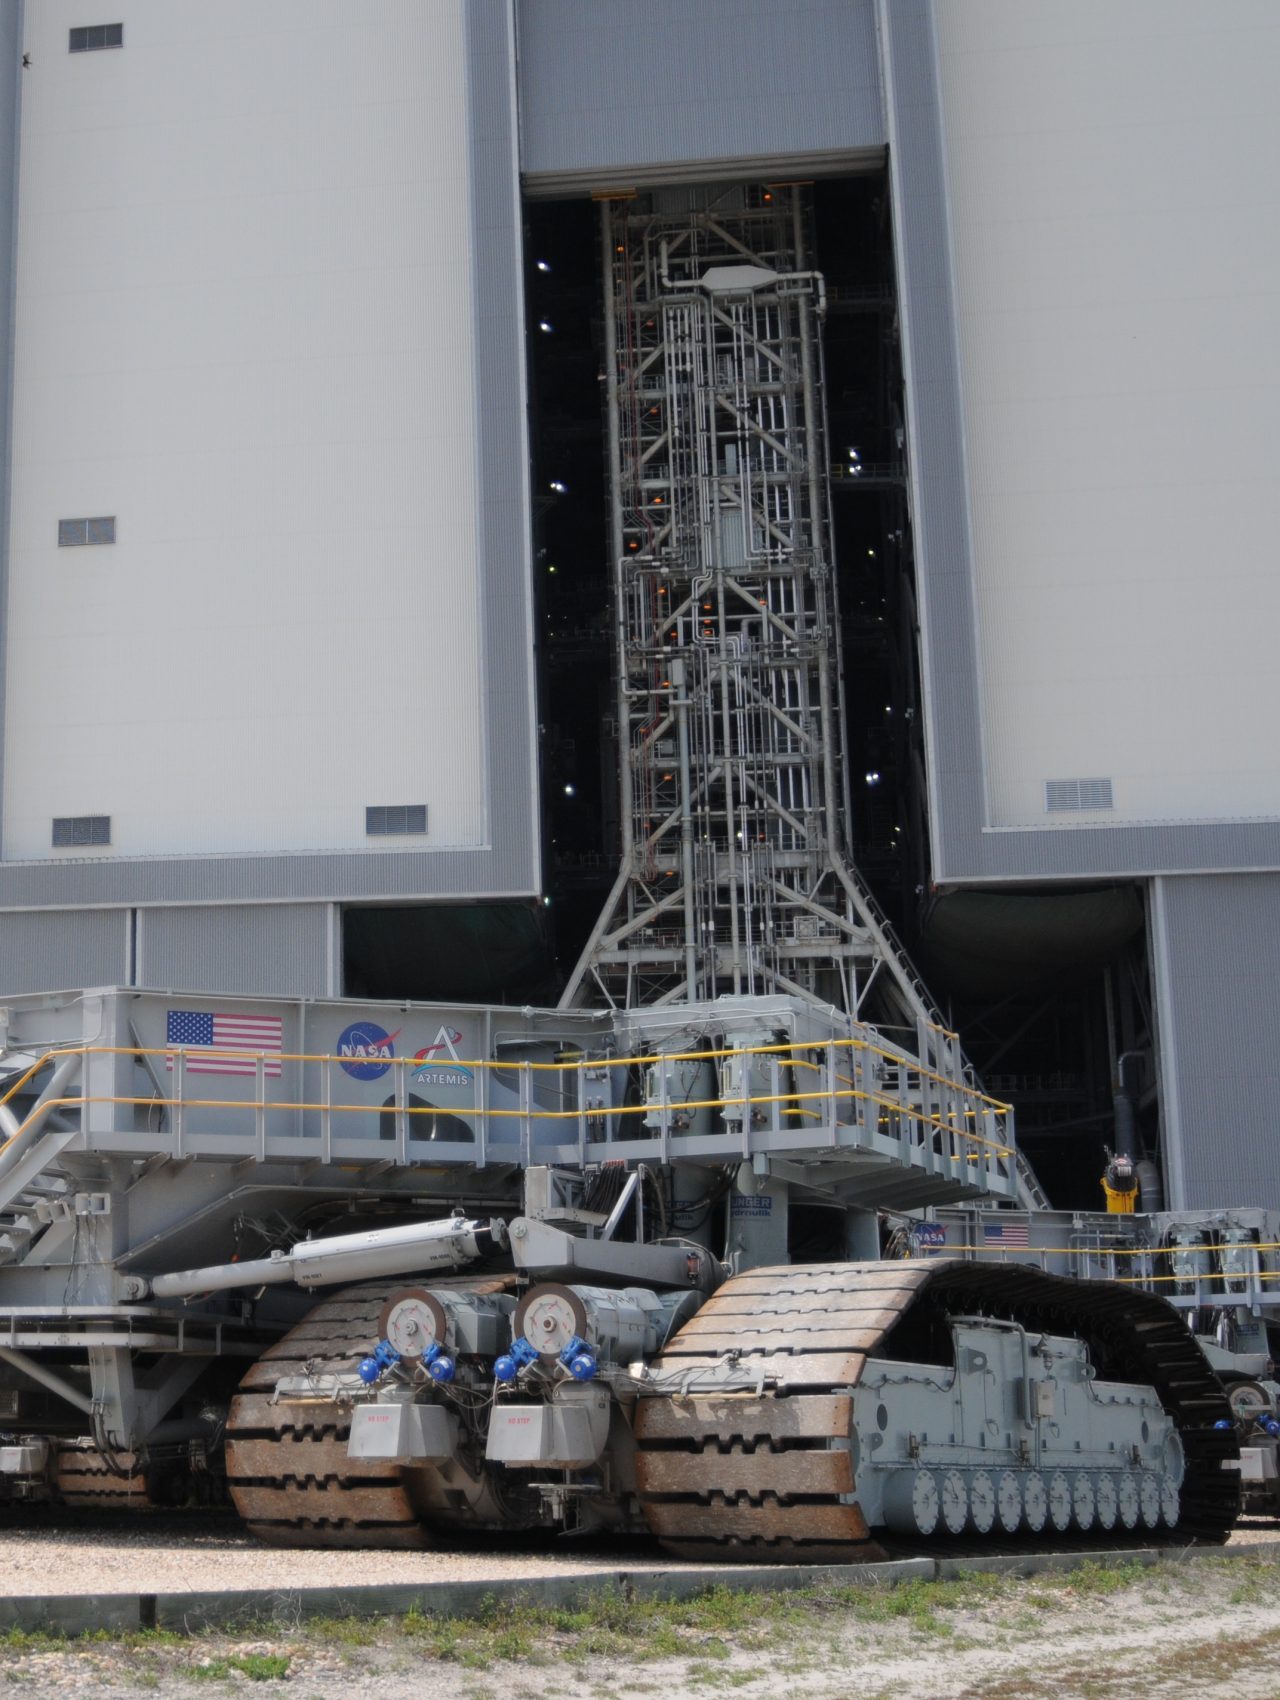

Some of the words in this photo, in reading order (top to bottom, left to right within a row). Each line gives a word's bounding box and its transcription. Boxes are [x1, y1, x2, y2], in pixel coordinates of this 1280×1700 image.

[341, 1044, 391, 1058] NASA
[417, 1073, 468, 1085] ARTEMIS
[731, 1197, 770, 1207] UNGER
